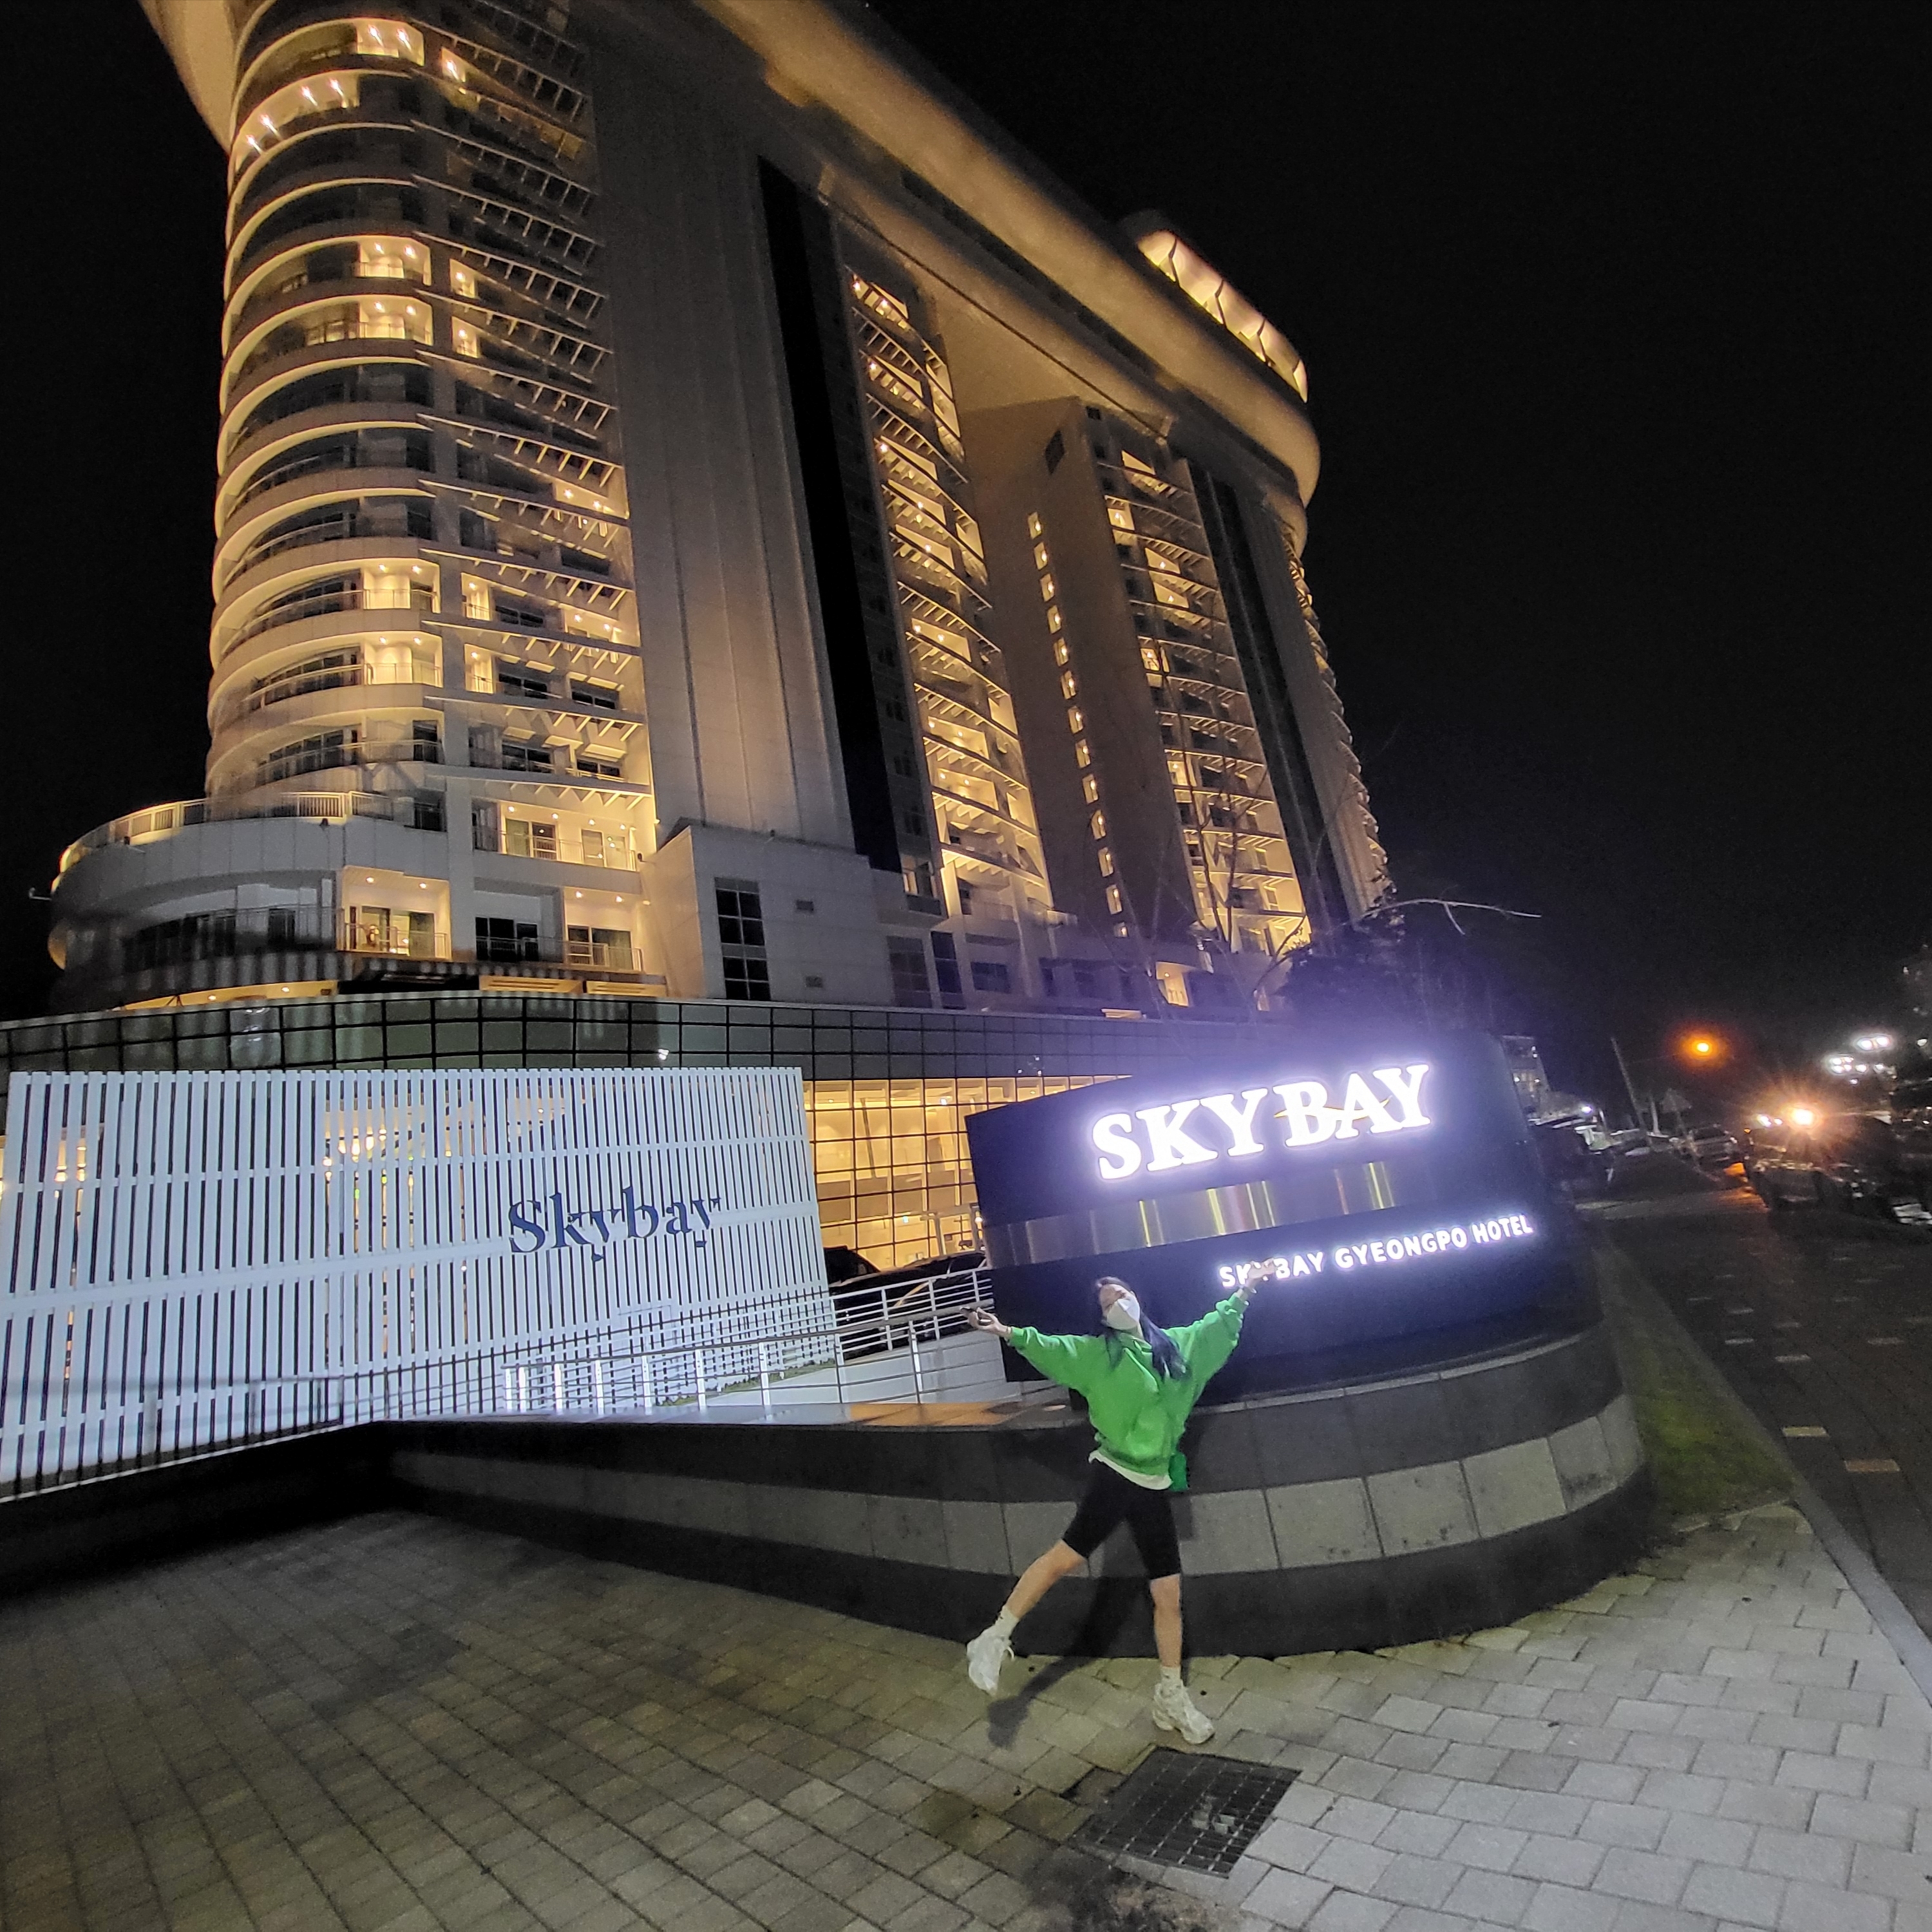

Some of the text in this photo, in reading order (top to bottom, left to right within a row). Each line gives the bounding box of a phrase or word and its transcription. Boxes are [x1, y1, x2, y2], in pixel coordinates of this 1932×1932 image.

[1092, 1064, 1431, 1180] SKYBAY
[508, 1185, 722, 1262] Skybay
[1334, 1227, 1468, 1269] GYEONGPO
[1472, 1215, 1533, 1244] HOTEL
